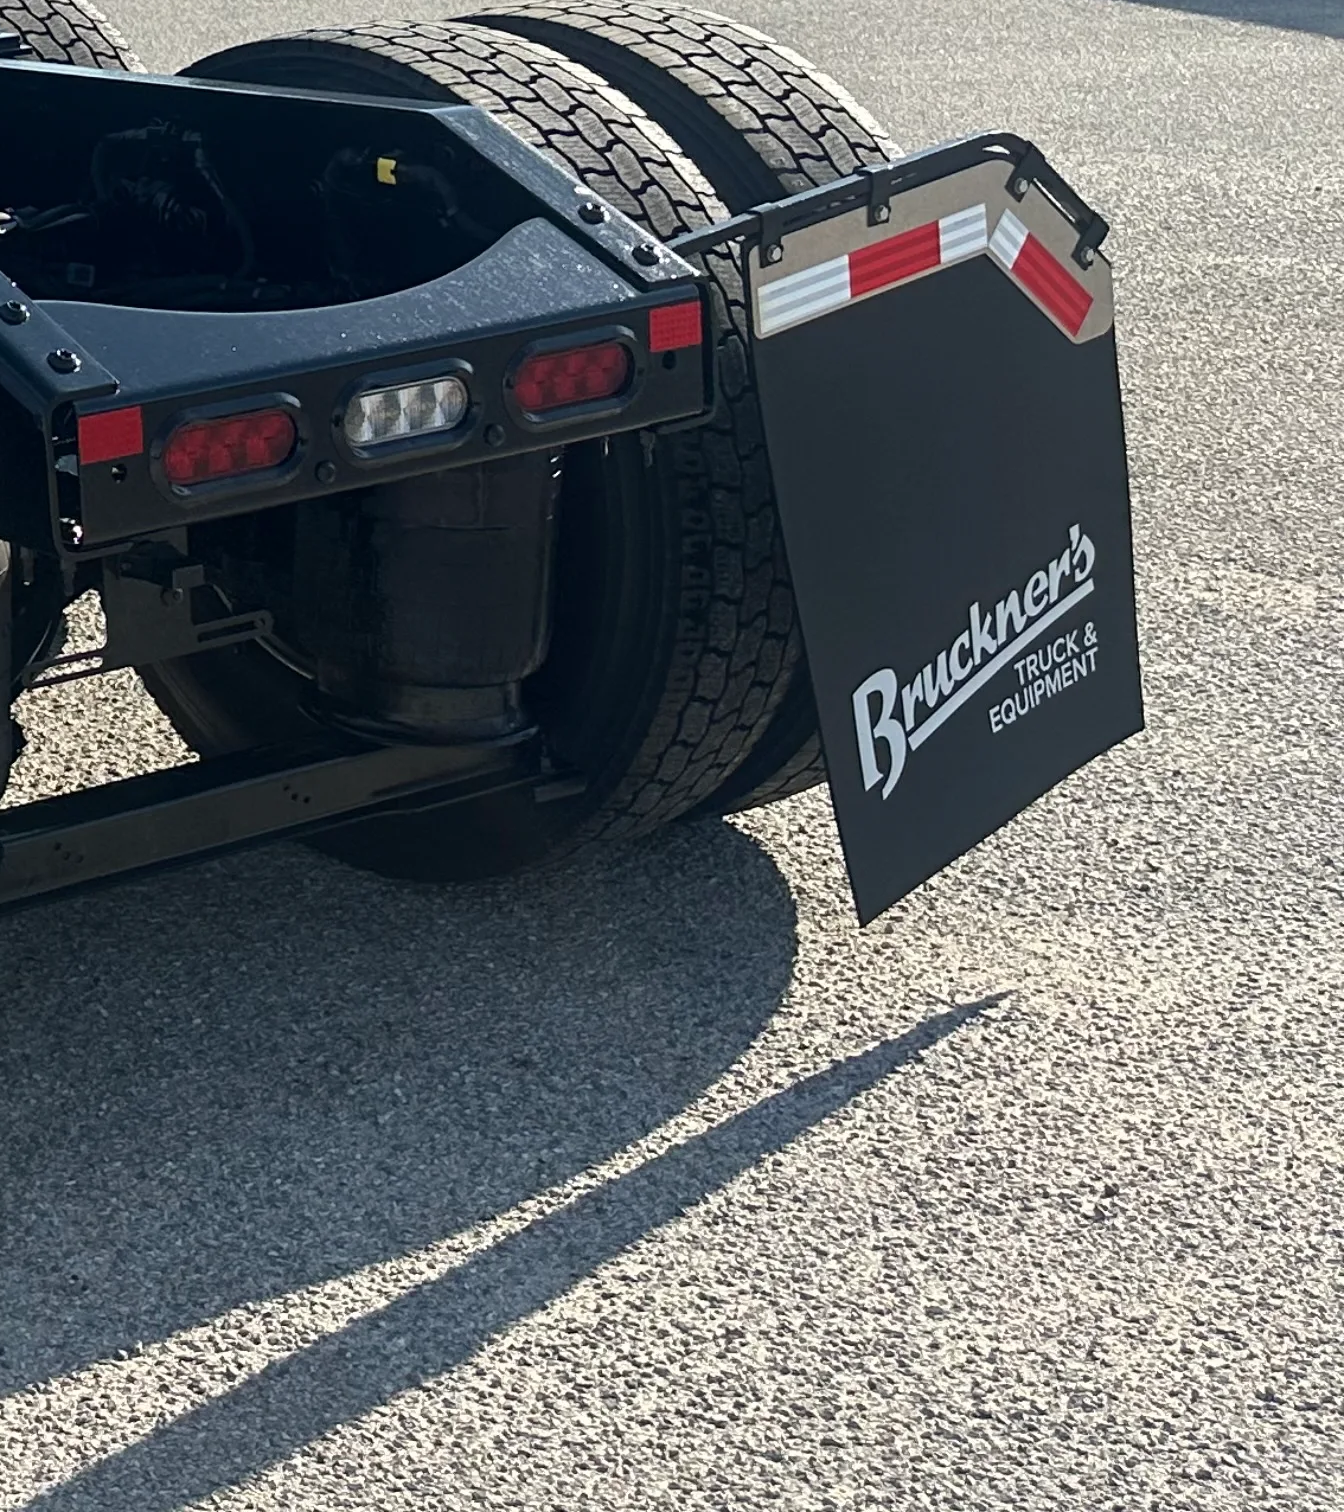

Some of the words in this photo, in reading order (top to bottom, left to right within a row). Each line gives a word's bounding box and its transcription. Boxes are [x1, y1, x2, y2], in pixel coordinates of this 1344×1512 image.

[853, 523, 1096, 800] Bruckner's
[990, 647, 1099, 734] EQUIPMENT
[1014, 630, 1080, 685] TRUCK
[1084, 621, 1098, 647] &
